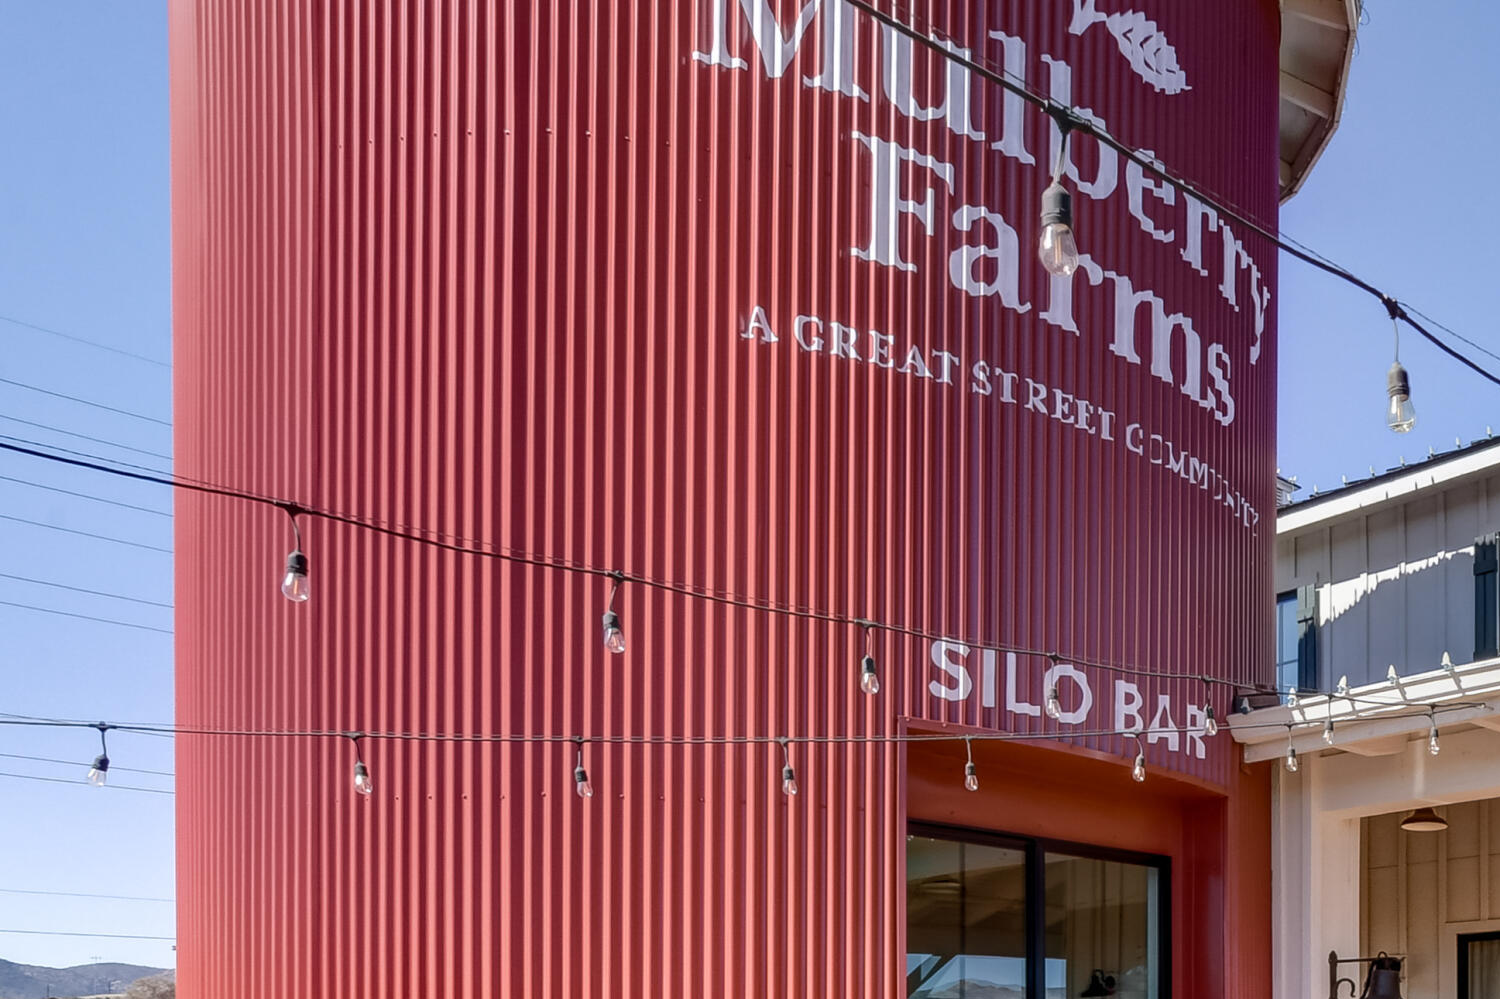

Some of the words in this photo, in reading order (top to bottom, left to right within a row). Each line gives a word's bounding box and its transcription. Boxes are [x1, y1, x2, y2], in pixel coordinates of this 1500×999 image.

[692, 0, 1270, 364] Mulberry
[851, 131, 1235, 426] Farms
[741, 305, 779, 343] A
[794, 314, 960, 386] GREAT
[971, 360, 1116, 441] STREET
[928, 637, 1093, 725] SILO
[1115, 680, 1207, 760] BAR
